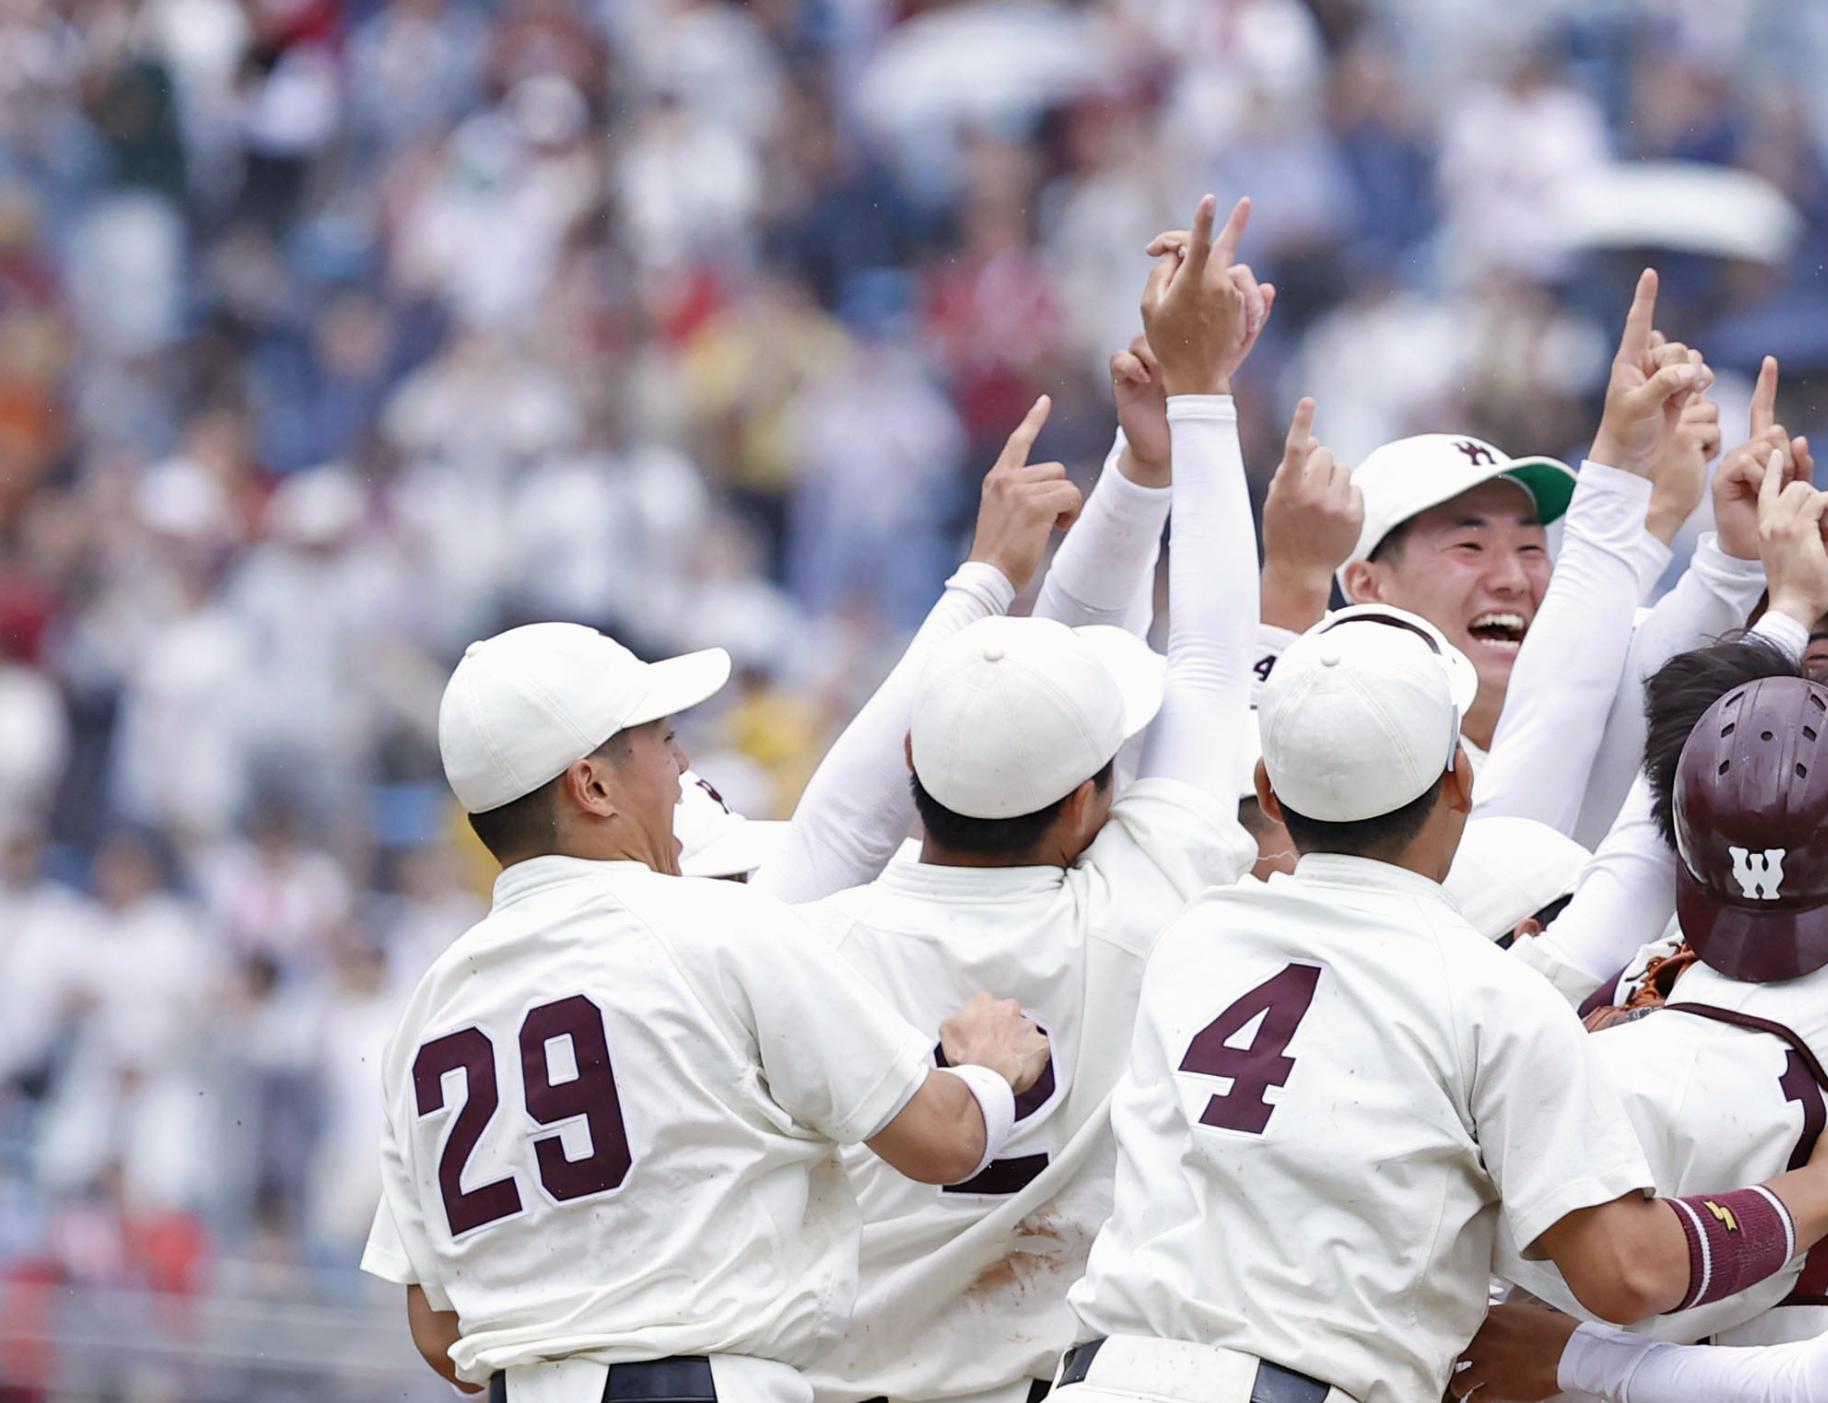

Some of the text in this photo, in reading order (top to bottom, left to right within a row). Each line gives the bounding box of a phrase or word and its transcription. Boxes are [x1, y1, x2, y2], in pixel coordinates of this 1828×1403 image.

[1728, 846, 1786, 900] W
[412, 994, 632, 1238] 29
[1178, 963, 1322, 1135] 4
